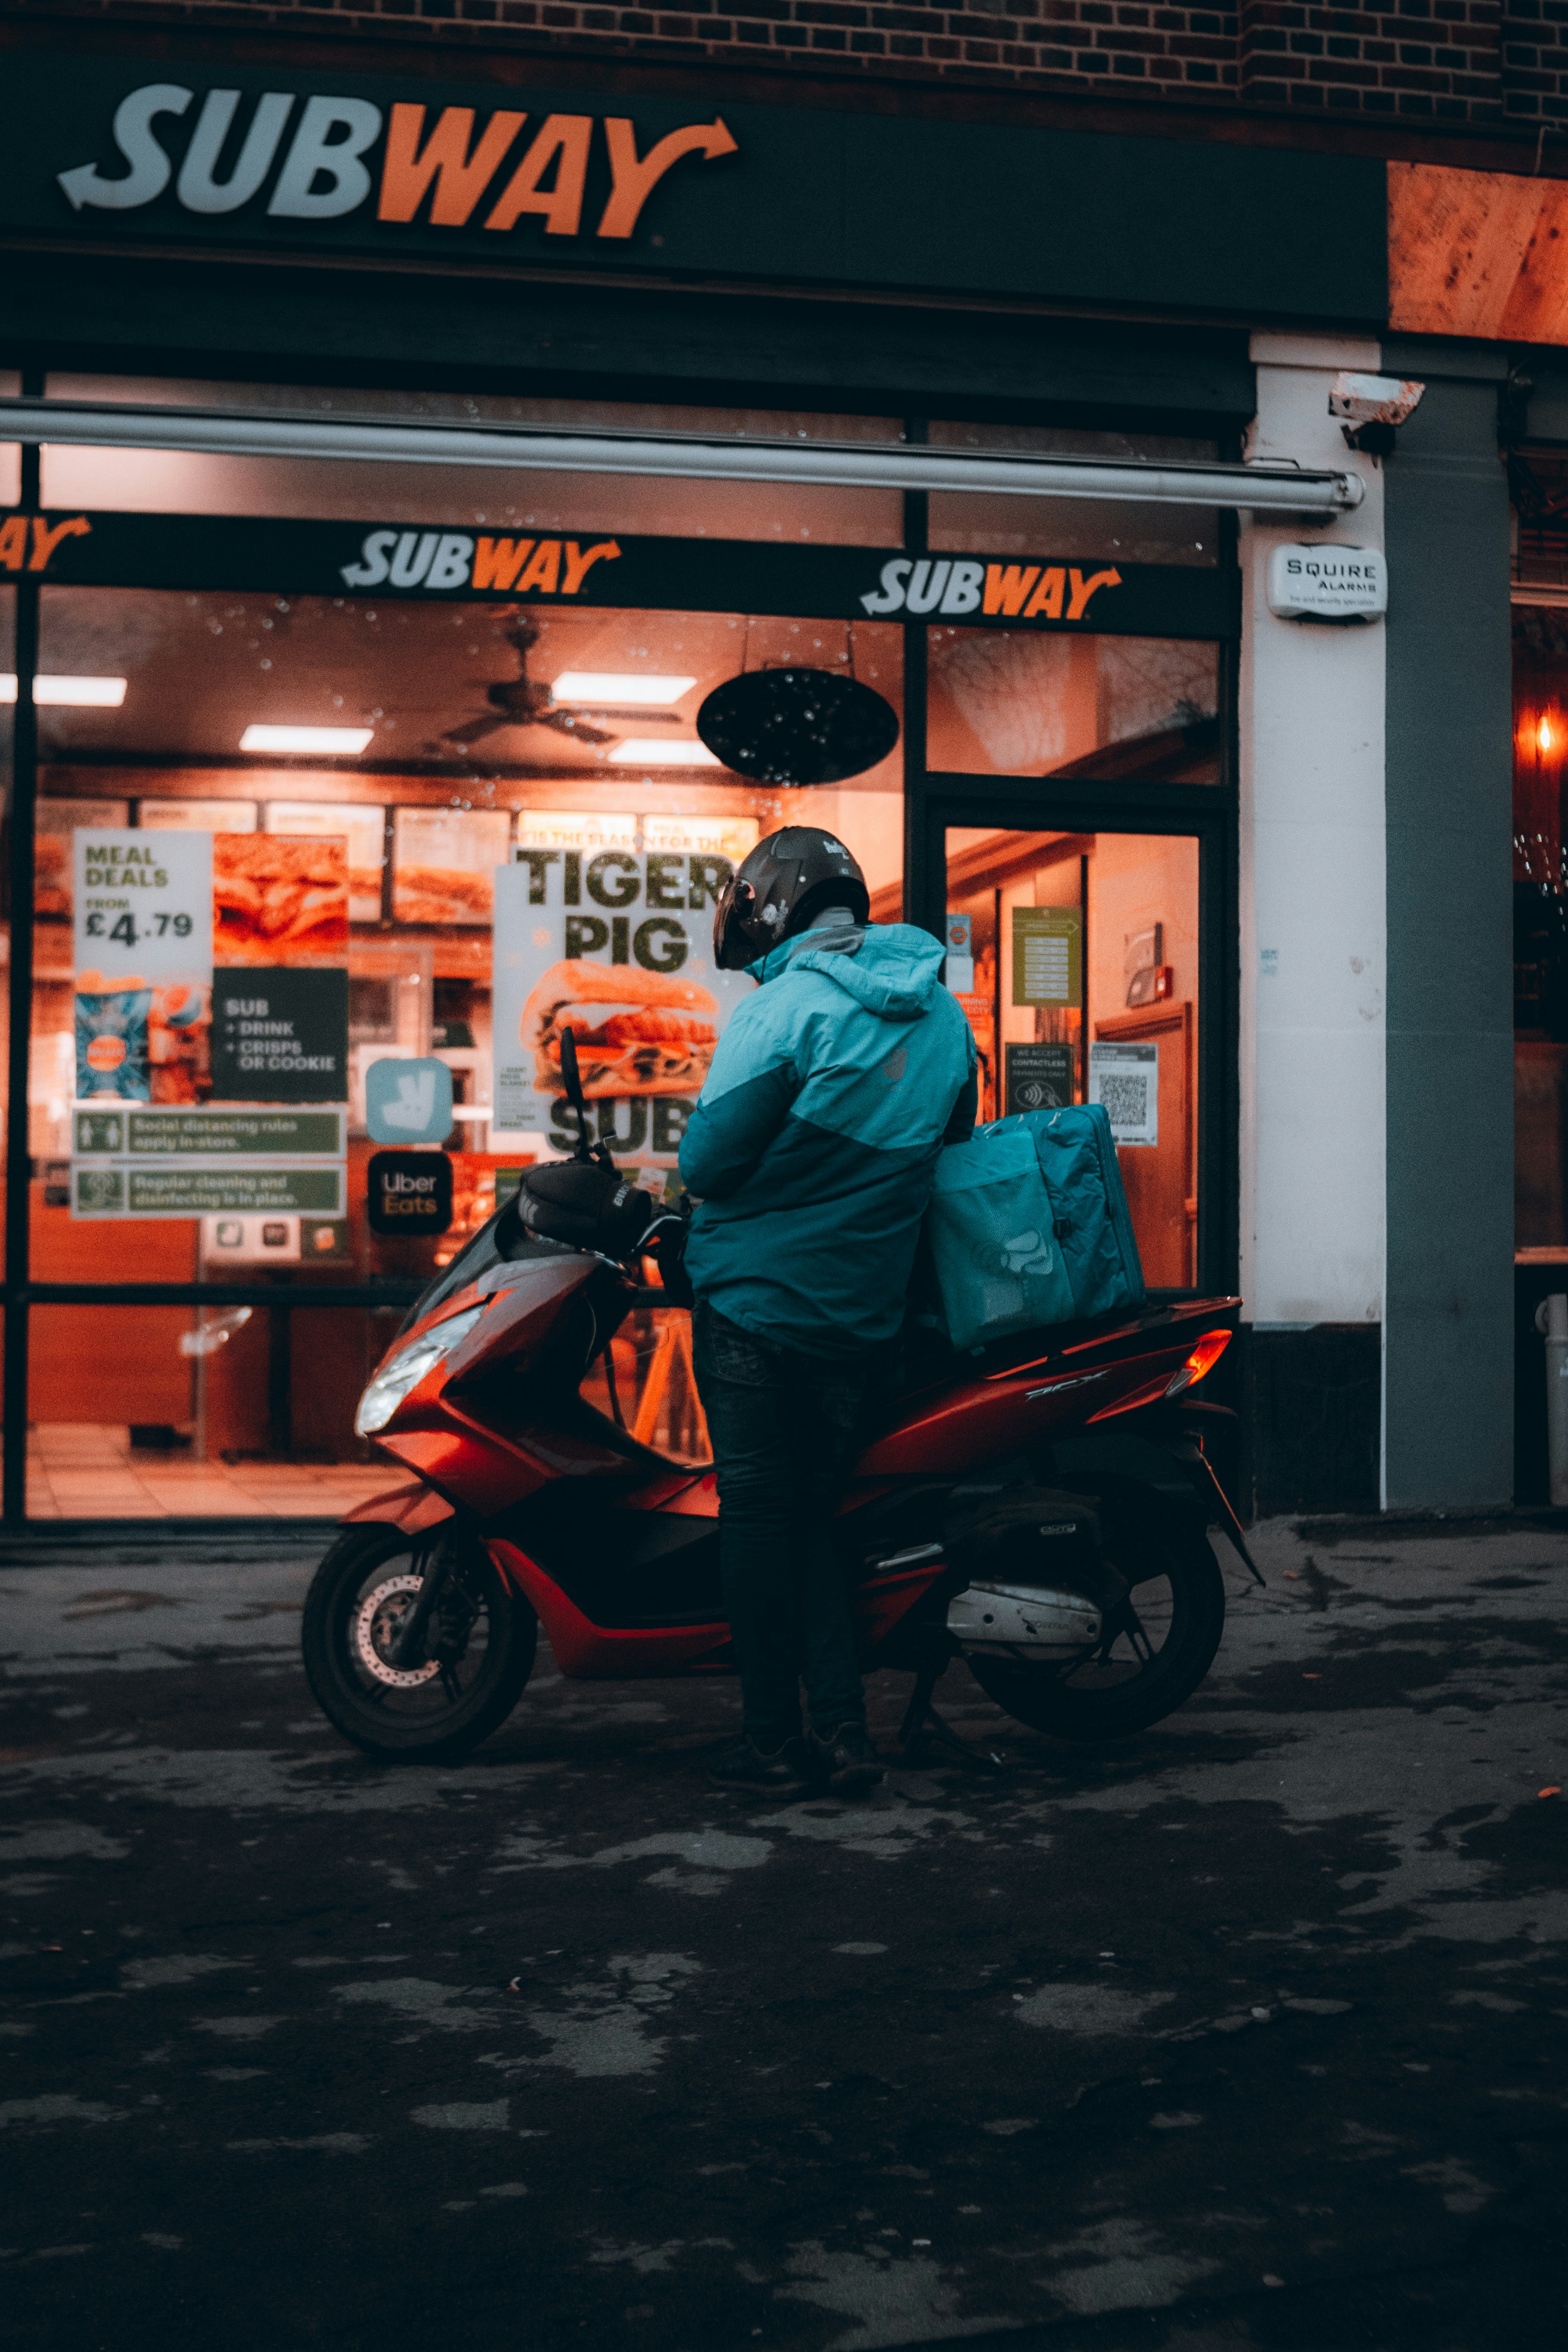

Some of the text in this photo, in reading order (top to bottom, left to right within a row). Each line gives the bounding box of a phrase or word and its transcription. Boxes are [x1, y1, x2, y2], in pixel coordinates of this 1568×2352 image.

[56, 83, 739, 238] SUBWAY
[341, 529, 621, 593] SUBWAY
[1287, 559, 1376, 578] SQUIRE
[860, 558, 1122, 620] SUBWAY
[1319, 580, 1376, 593] ALARMS
[85, 846, 157, 866] MEAL
[85, 868, 169, 888] DEALS
[516, 850, 734, 911] TIGER
[85, 899, 130, 909] FROM
[85, 912, 193, 948] £4.79
[565, 915, 689, 973] PIG
[225, 999, 270, 1017] SUB
[240, 1021, 295, 1036] DRINK
[240, 1040, 303, 1055] CRISPS
[240, 1056, 336, 1071] OR COOKIE
[1012, 1059, 1067, 1067] CONTACTLESS
[133, 1118, 298, 1136] Social distancing rules
[550, 1096, 697, 1153] SUB
[133, 1135, 176, 1150] apply
[134, 1175, 287, 1193] Regular cleaning and
[381, 1172, 437, 1193] Uber
[239, 1193, 253, 1204] in
[382, 1196, 438, 1215] Eats
